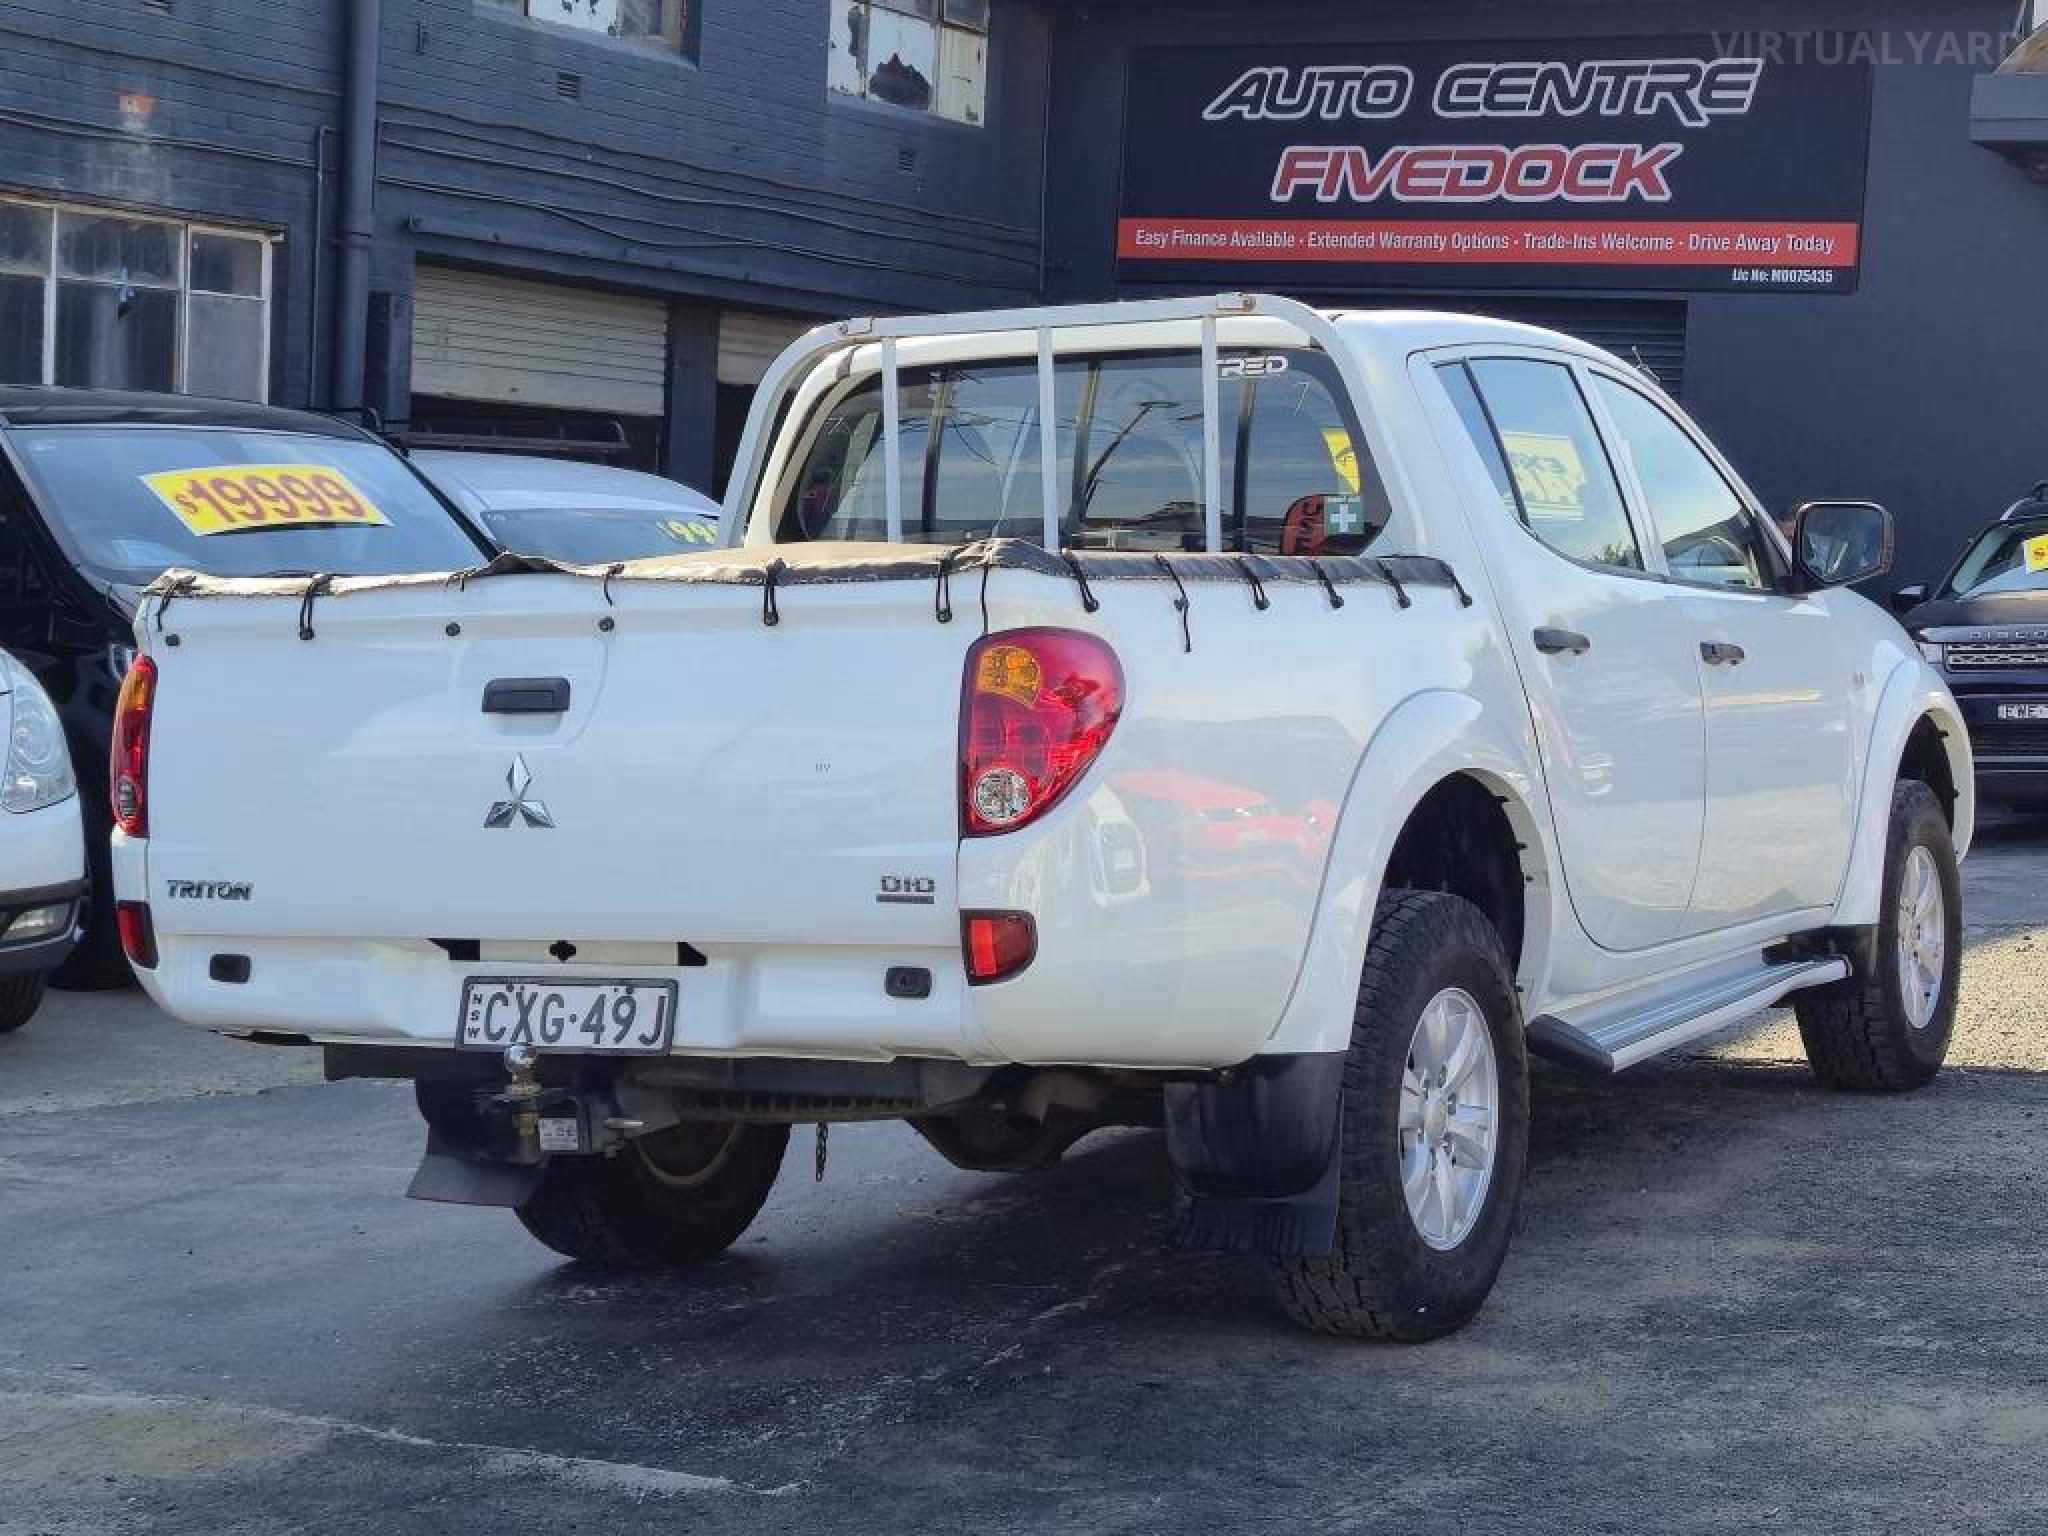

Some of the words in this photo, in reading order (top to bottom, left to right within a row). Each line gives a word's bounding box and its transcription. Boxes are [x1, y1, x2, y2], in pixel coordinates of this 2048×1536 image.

[1202, 65, 1414, 120] AUTO
[1431, 57, 1764, 127] CENTRE
[1270, 143, 1683, 202] FIVEDOCK
[1135, 229, 1168, 248] Easy
[1172, 229, 1227, 247] Finance
[1230, 230, 1295, 248] Available
[1308, 231, 1375, 249] Extended
[1380, 231, 1447, 252] Warranty
[1452, 231, 1509, 252] Options
[1523, 233, 1597, 250] Trade-Ins
[1600, 233, 1673, 250] Welcome
[1688, 233, 1731, 251] Drive
[1735, 233, 1781, 254] Away
[1786, 234, 1834, 254] Today
[175, 473, 366, 523] $19999
[166, 879, 256, 901] TRITON
